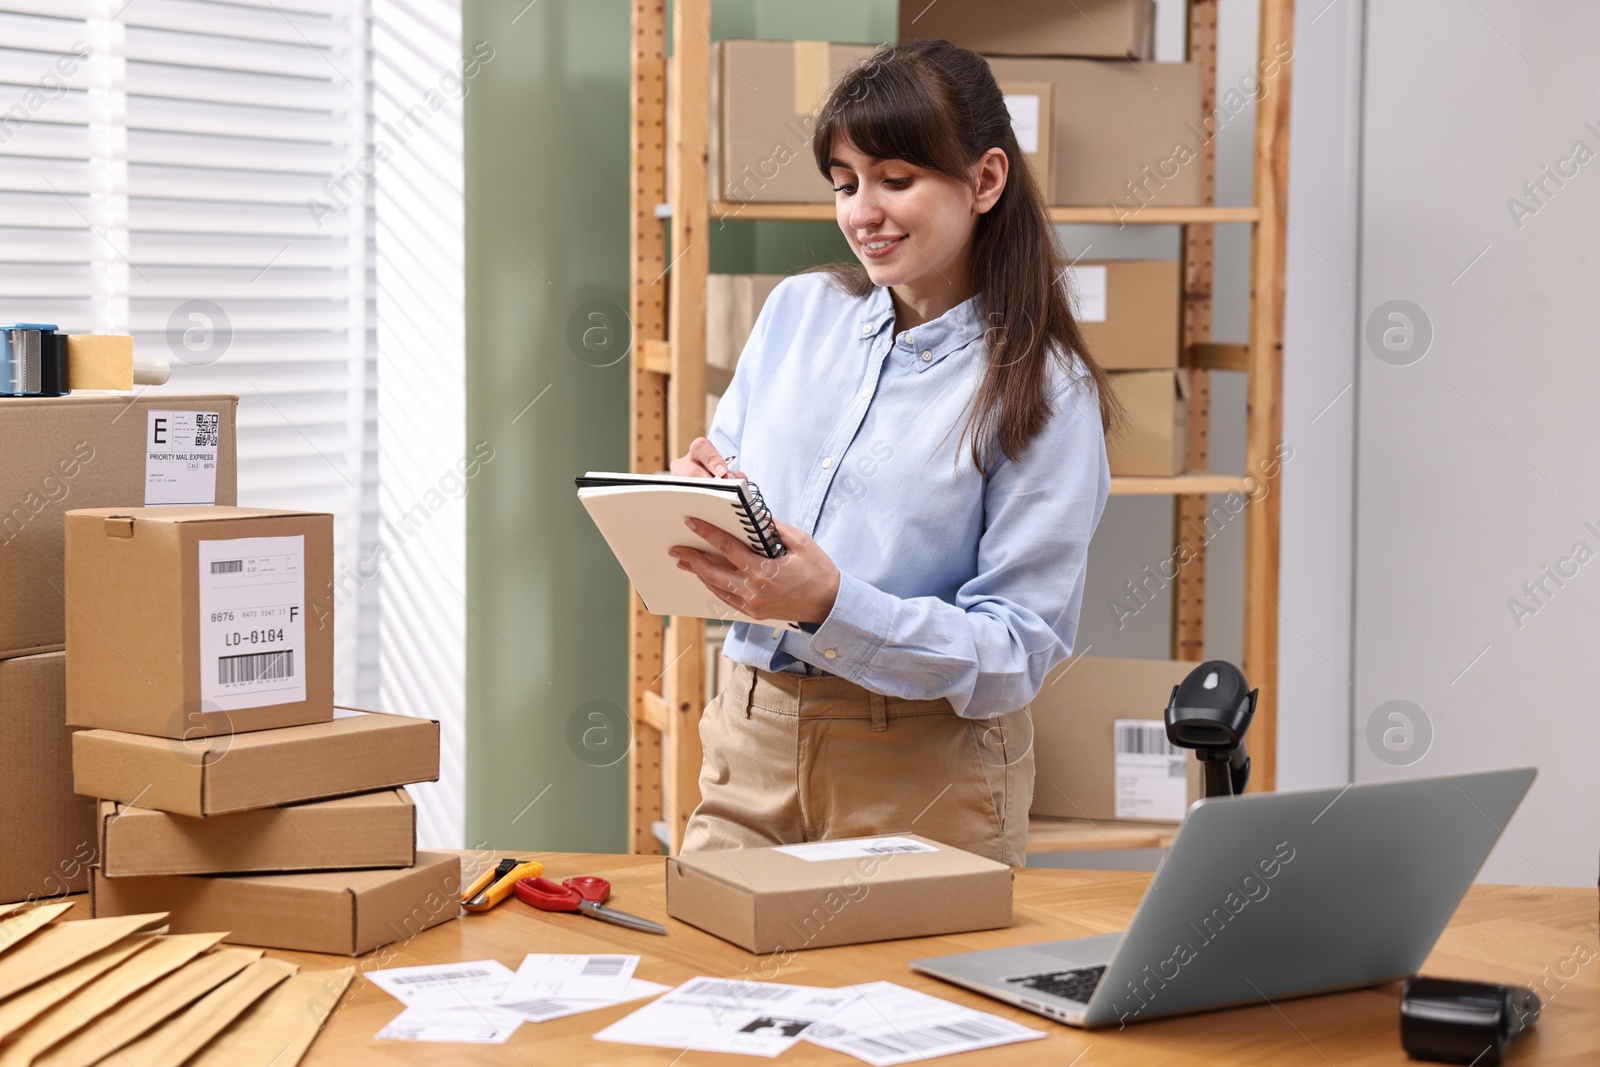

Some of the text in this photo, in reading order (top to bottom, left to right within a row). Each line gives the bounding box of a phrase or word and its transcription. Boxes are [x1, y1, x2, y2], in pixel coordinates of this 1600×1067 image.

[154, 418, 167, 444] E
[149, 453, 214, 461] PRIORITY MAIL EXPRESS
[290, 606, 299, 623] F
[225, 628, 284, 646] LD-0104
